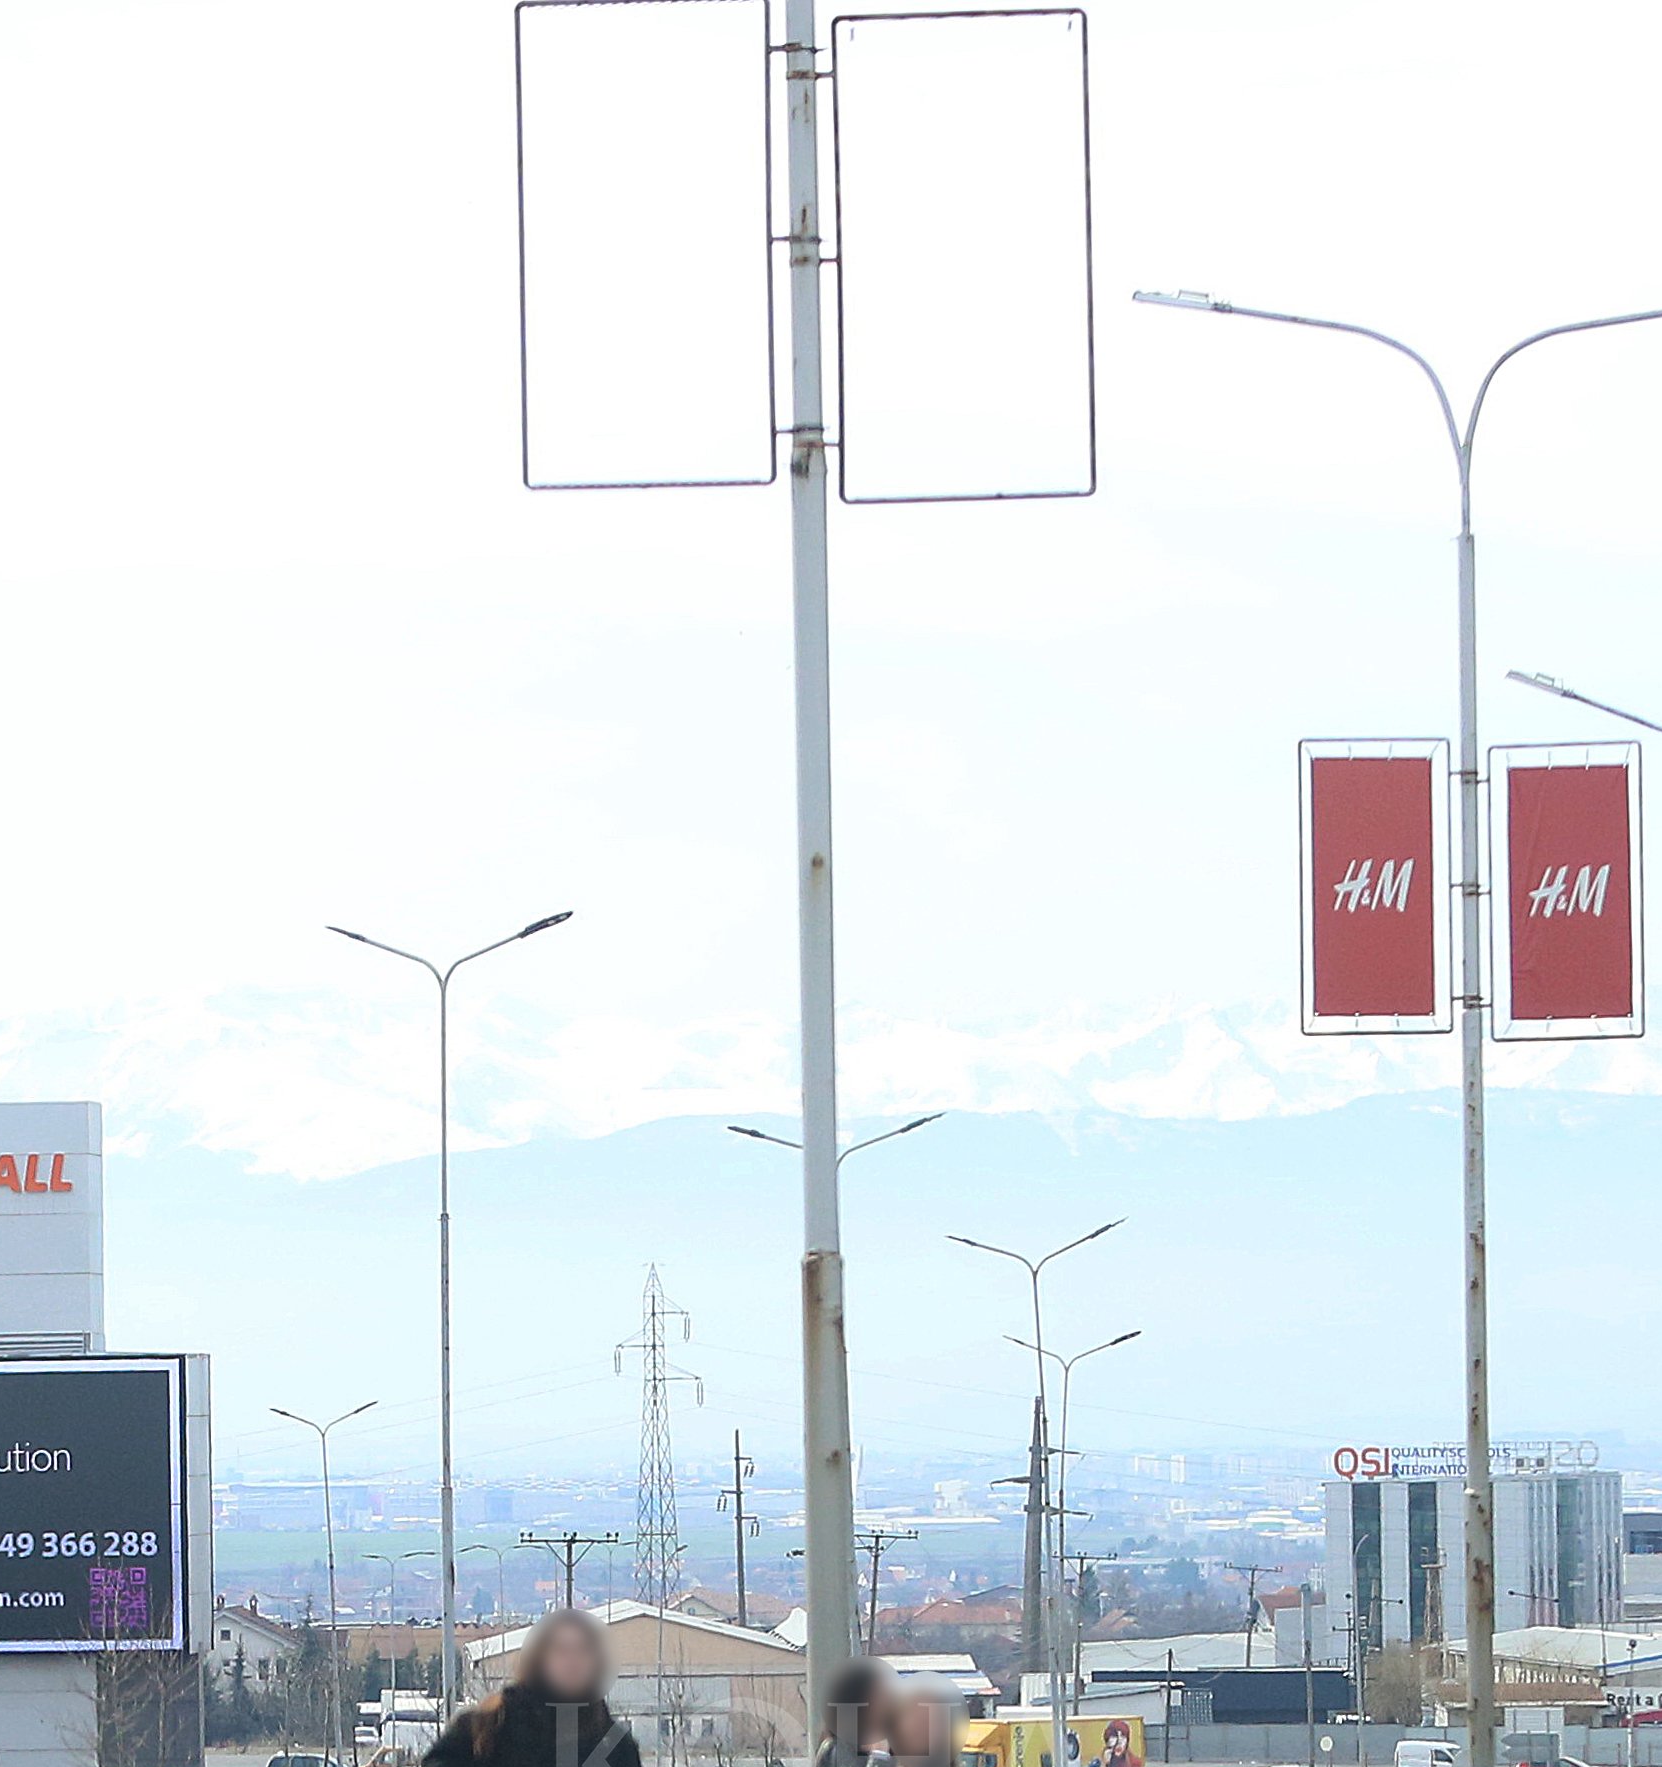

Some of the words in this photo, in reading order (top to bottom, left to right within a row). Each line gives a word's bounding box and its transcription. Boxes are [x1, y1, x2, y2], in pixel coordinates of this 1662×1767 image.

[1333, 857, 1416, 913] H&M
[1529, 863, 1610, 918] H&M
[1392, 1447, 1447, 1460] QUALITY
[1448, 1447, 1511, 1459] SCOLS
[42, 1531, 97, 1558] 366
[103, 1530, 158, 1558] 288
